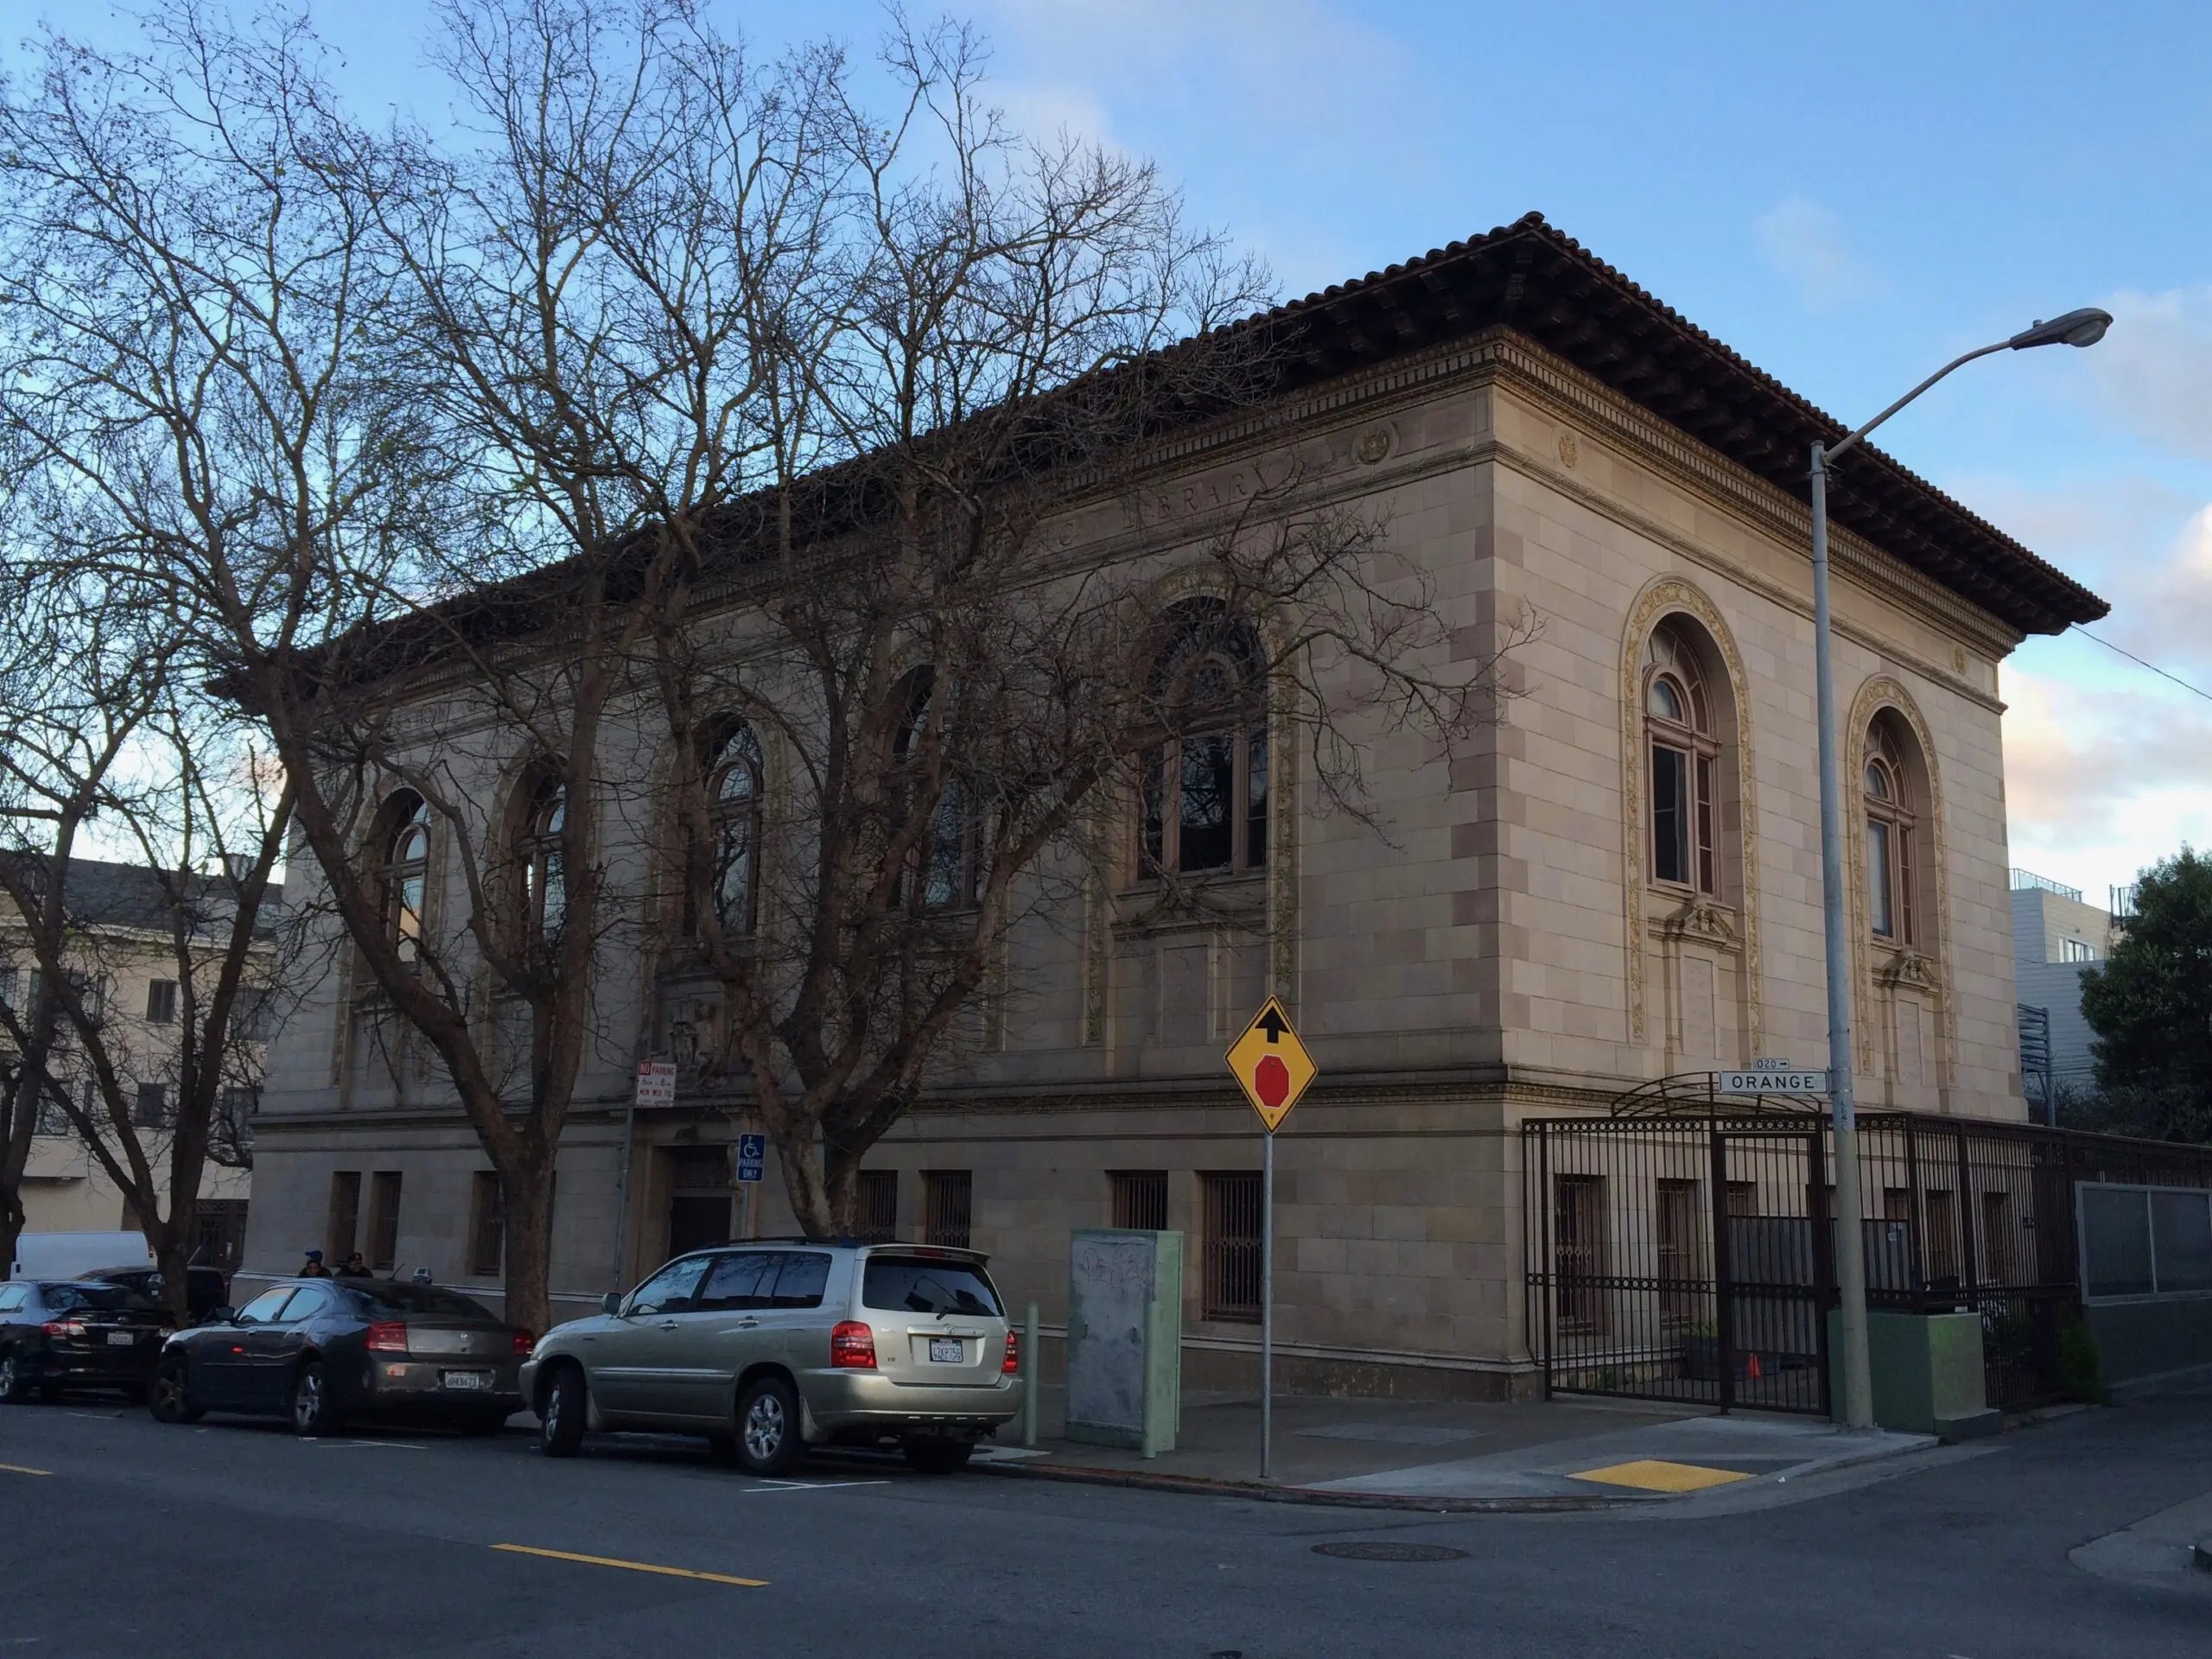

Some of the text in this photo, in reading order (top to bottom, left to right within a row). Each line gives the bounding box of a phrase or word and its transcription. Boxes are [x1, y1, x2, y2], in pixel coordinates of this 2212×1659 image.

[1120, 463, 1274, 529] LBRARY
[639, 1063, 651, 1074] NO
[1732, 1076, 1815, 1089] ORANGE
[739, 1158, 763, 1167] PARKING
[743, 1168, 758, 1179] ONLY
